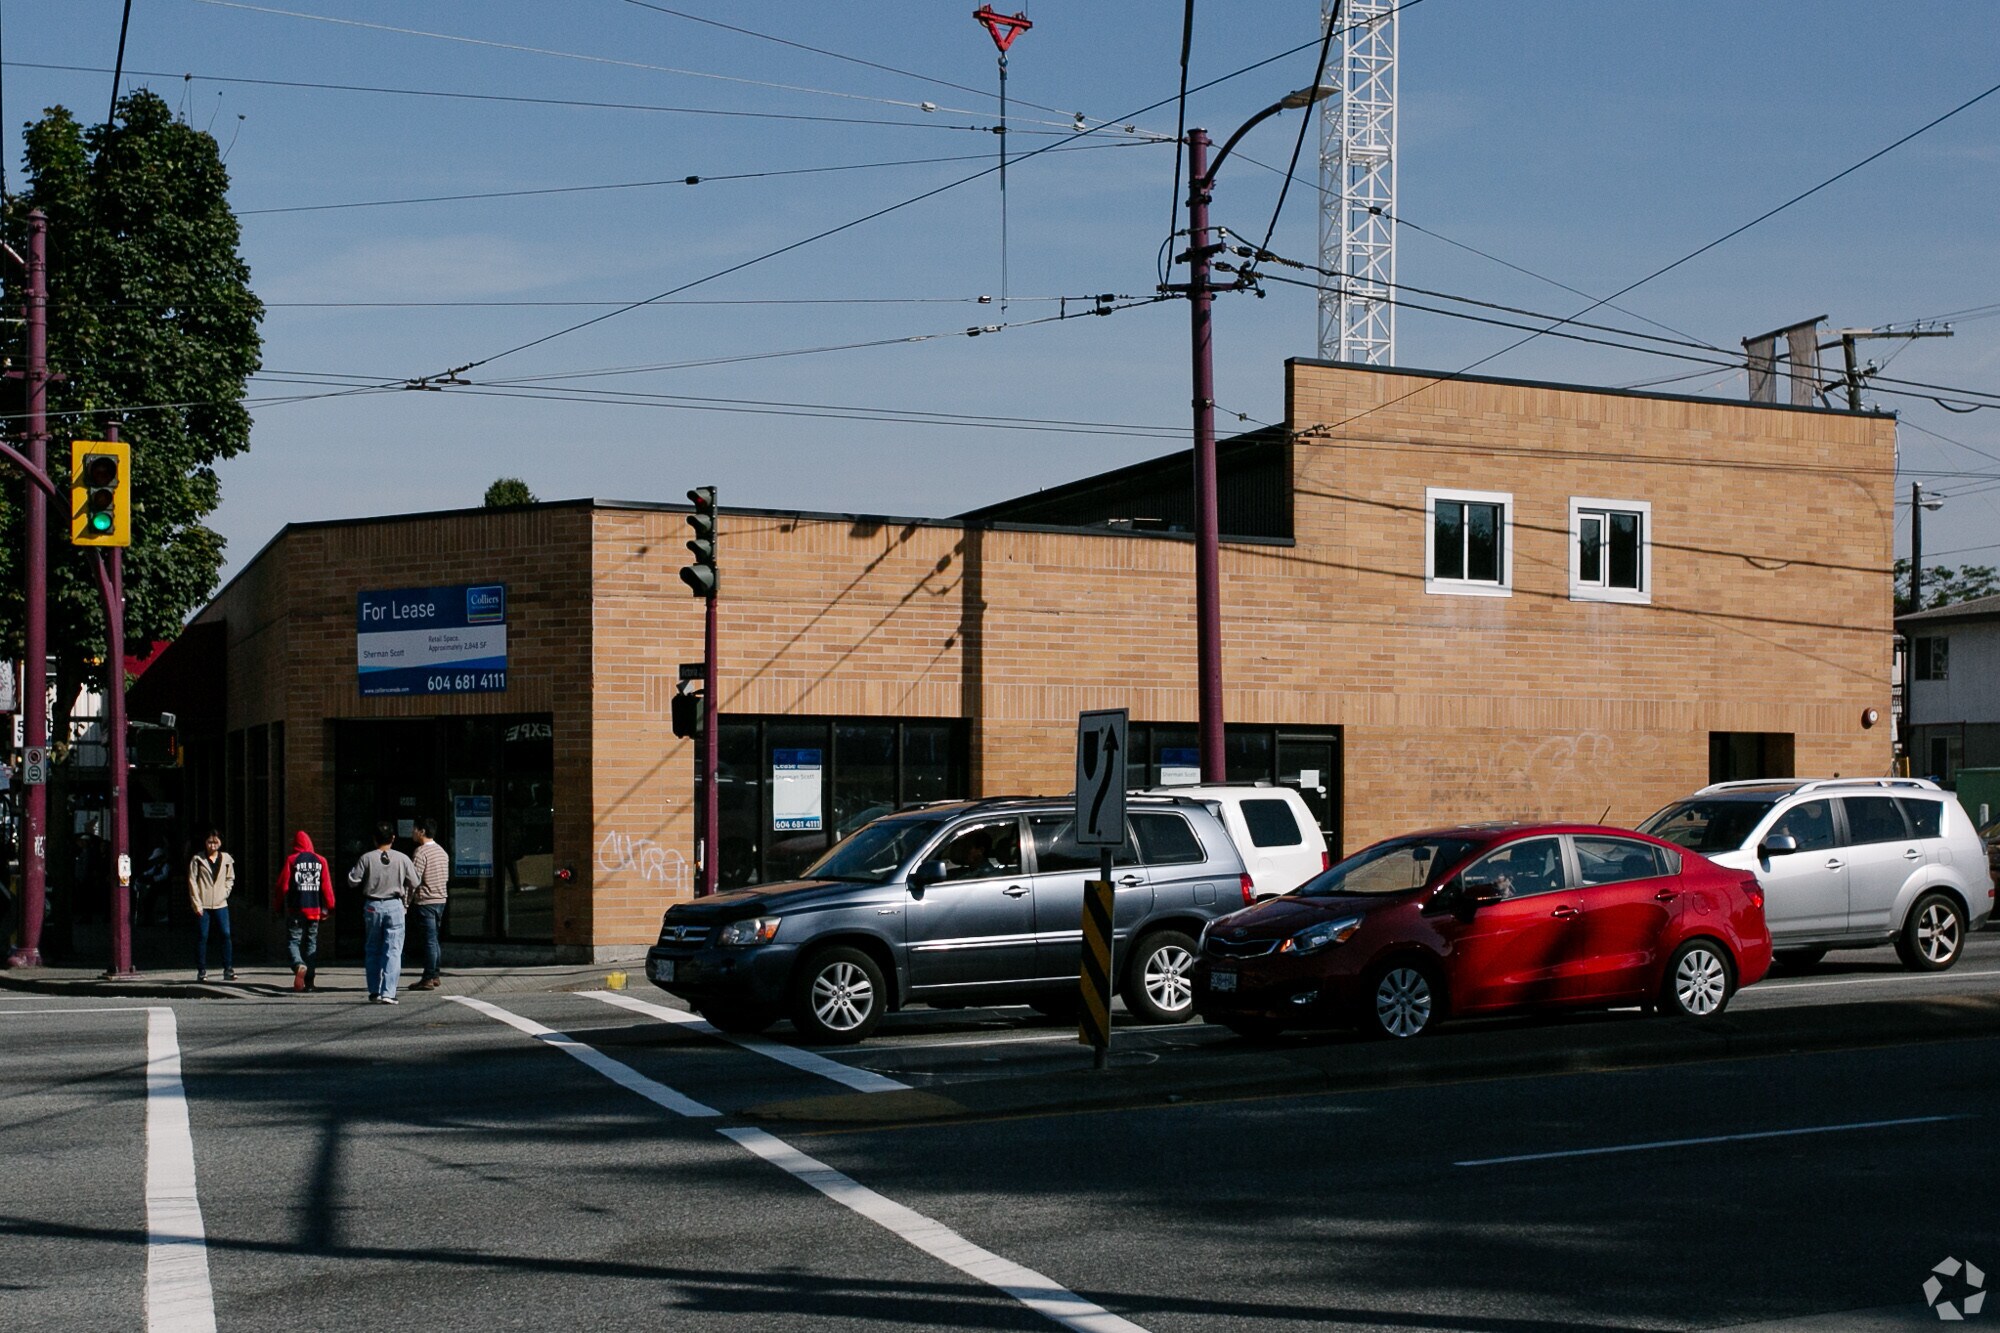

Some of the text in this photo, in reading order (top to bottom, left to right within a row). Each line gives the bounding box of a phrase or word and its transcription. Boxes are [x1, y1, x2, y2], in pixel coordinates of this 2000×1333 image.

[471, 593, 500, 605] Colliers
[363, 600, 436, 621] For Lease
[428, 634, 459, 643] Retail Space
[479, 641, 488, 650] SF
[363, 648, 405, 659] Sherman Scott
[427, 672, 505, 691] 604 681 4111
[776, 821, 790, 829] 604
[805, 820, 820, 828] 4111
